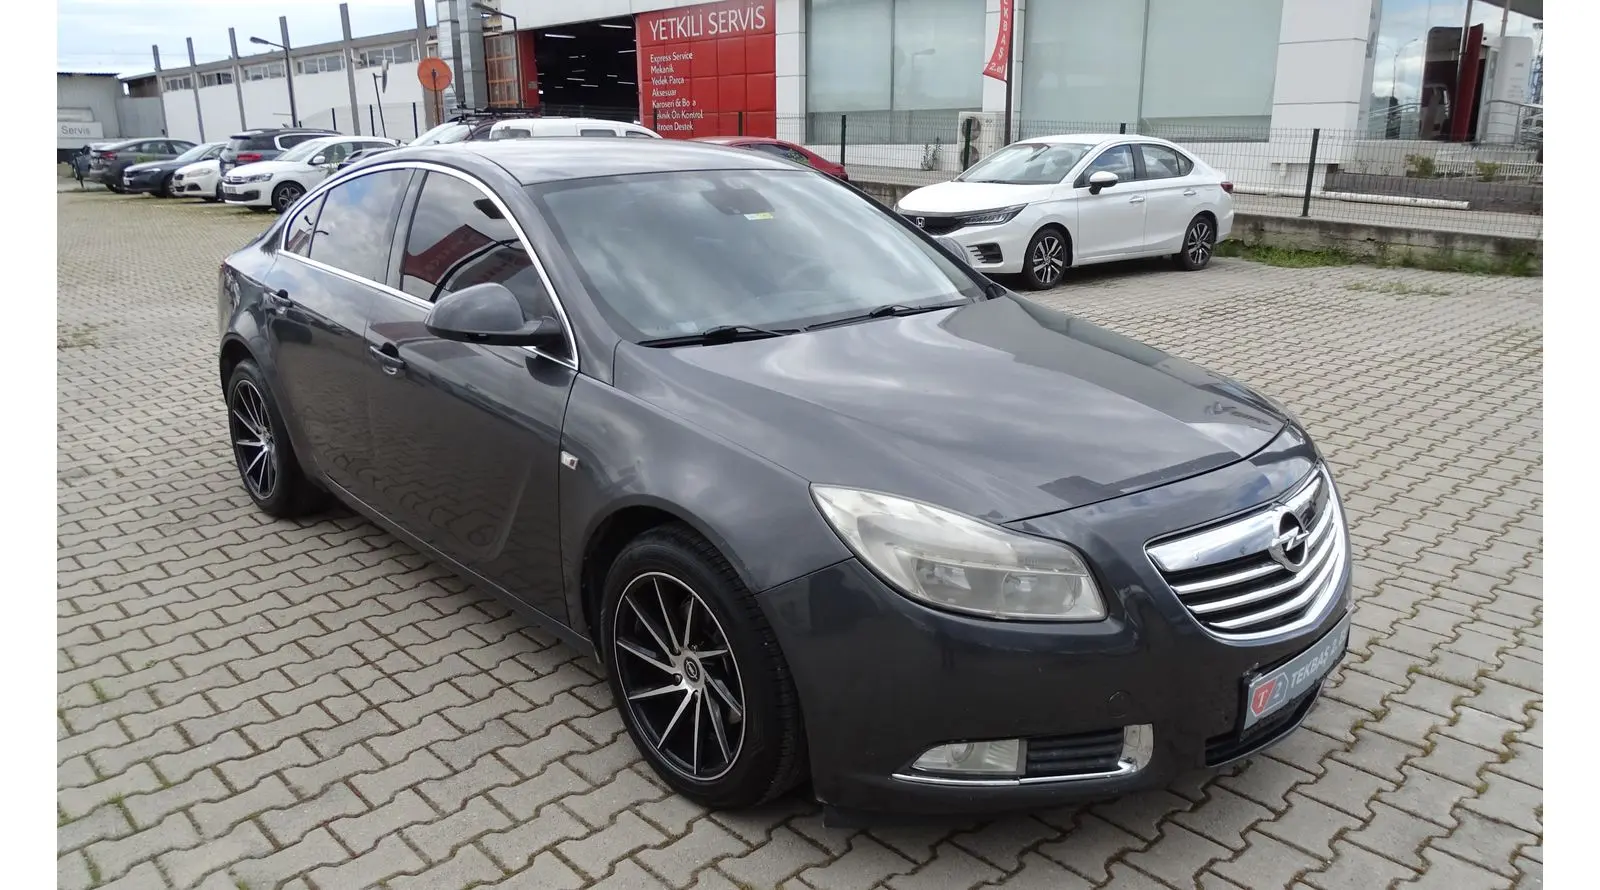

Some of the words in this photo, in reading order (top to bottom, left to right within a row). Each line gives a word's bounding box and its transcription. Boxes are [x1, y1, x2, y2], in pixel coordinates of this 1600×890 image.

[649, 11, 703, 40] YETKİLİ
[708, 2, 766, 35] SERVİS
[650, 53, 671, 64] Express
[672, 51, 693, 61] Service
[650, 64, 674, 74] Mekanik
[651, 76, 668, 86] Yedek
[652, 88, 677, 97] Aksesuar
[652, 99, 675, 109] Karoseri
[675, 98, 681, 107] &
[681, 108, 704, 119] Kontrol
[61, 126, 90, 134] Servis
[656, 122, 674, 131] itroen
[674, 121, 694, 131] Destek
